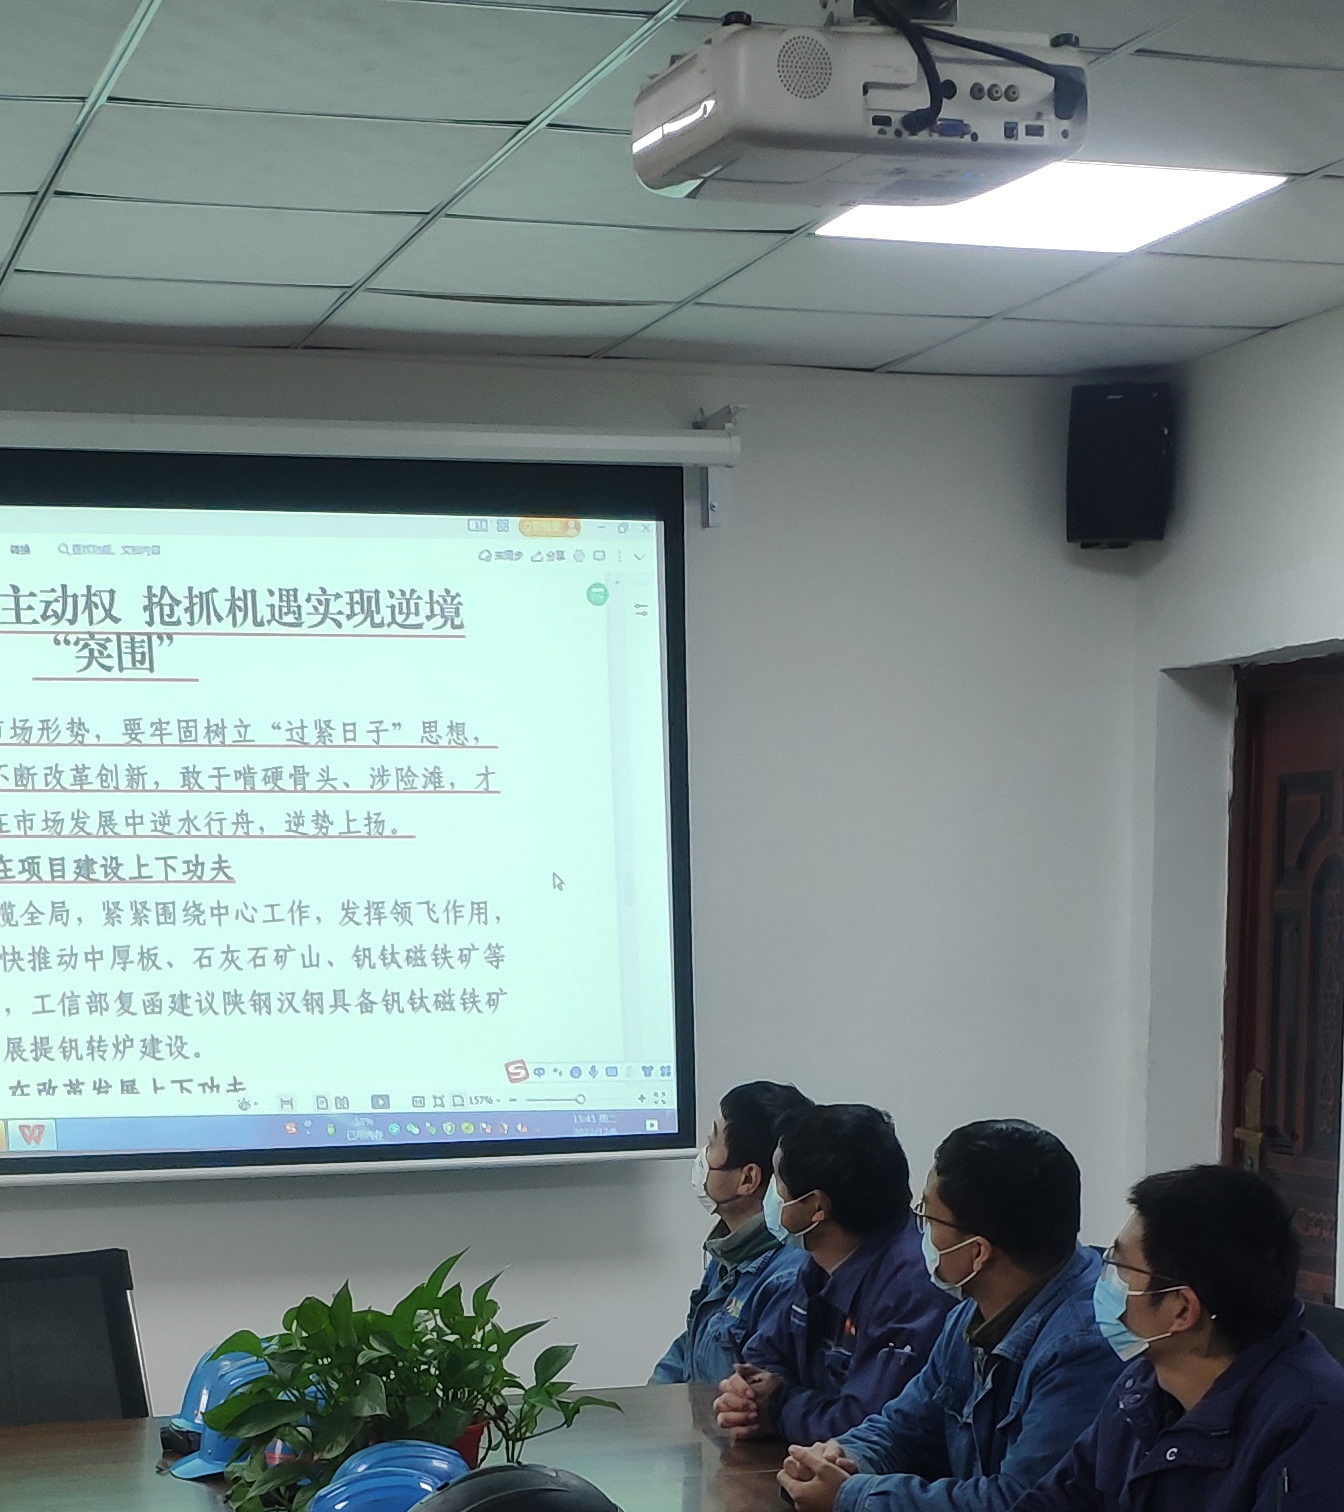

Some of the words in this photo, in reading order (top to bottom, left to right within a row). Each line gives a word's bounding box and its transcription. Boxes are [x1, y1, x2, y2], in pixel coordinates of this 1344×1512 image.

[143, 584, 465, 632] 抢抓机遇实现逆境
[53, 632, 174, 674] “突围”
